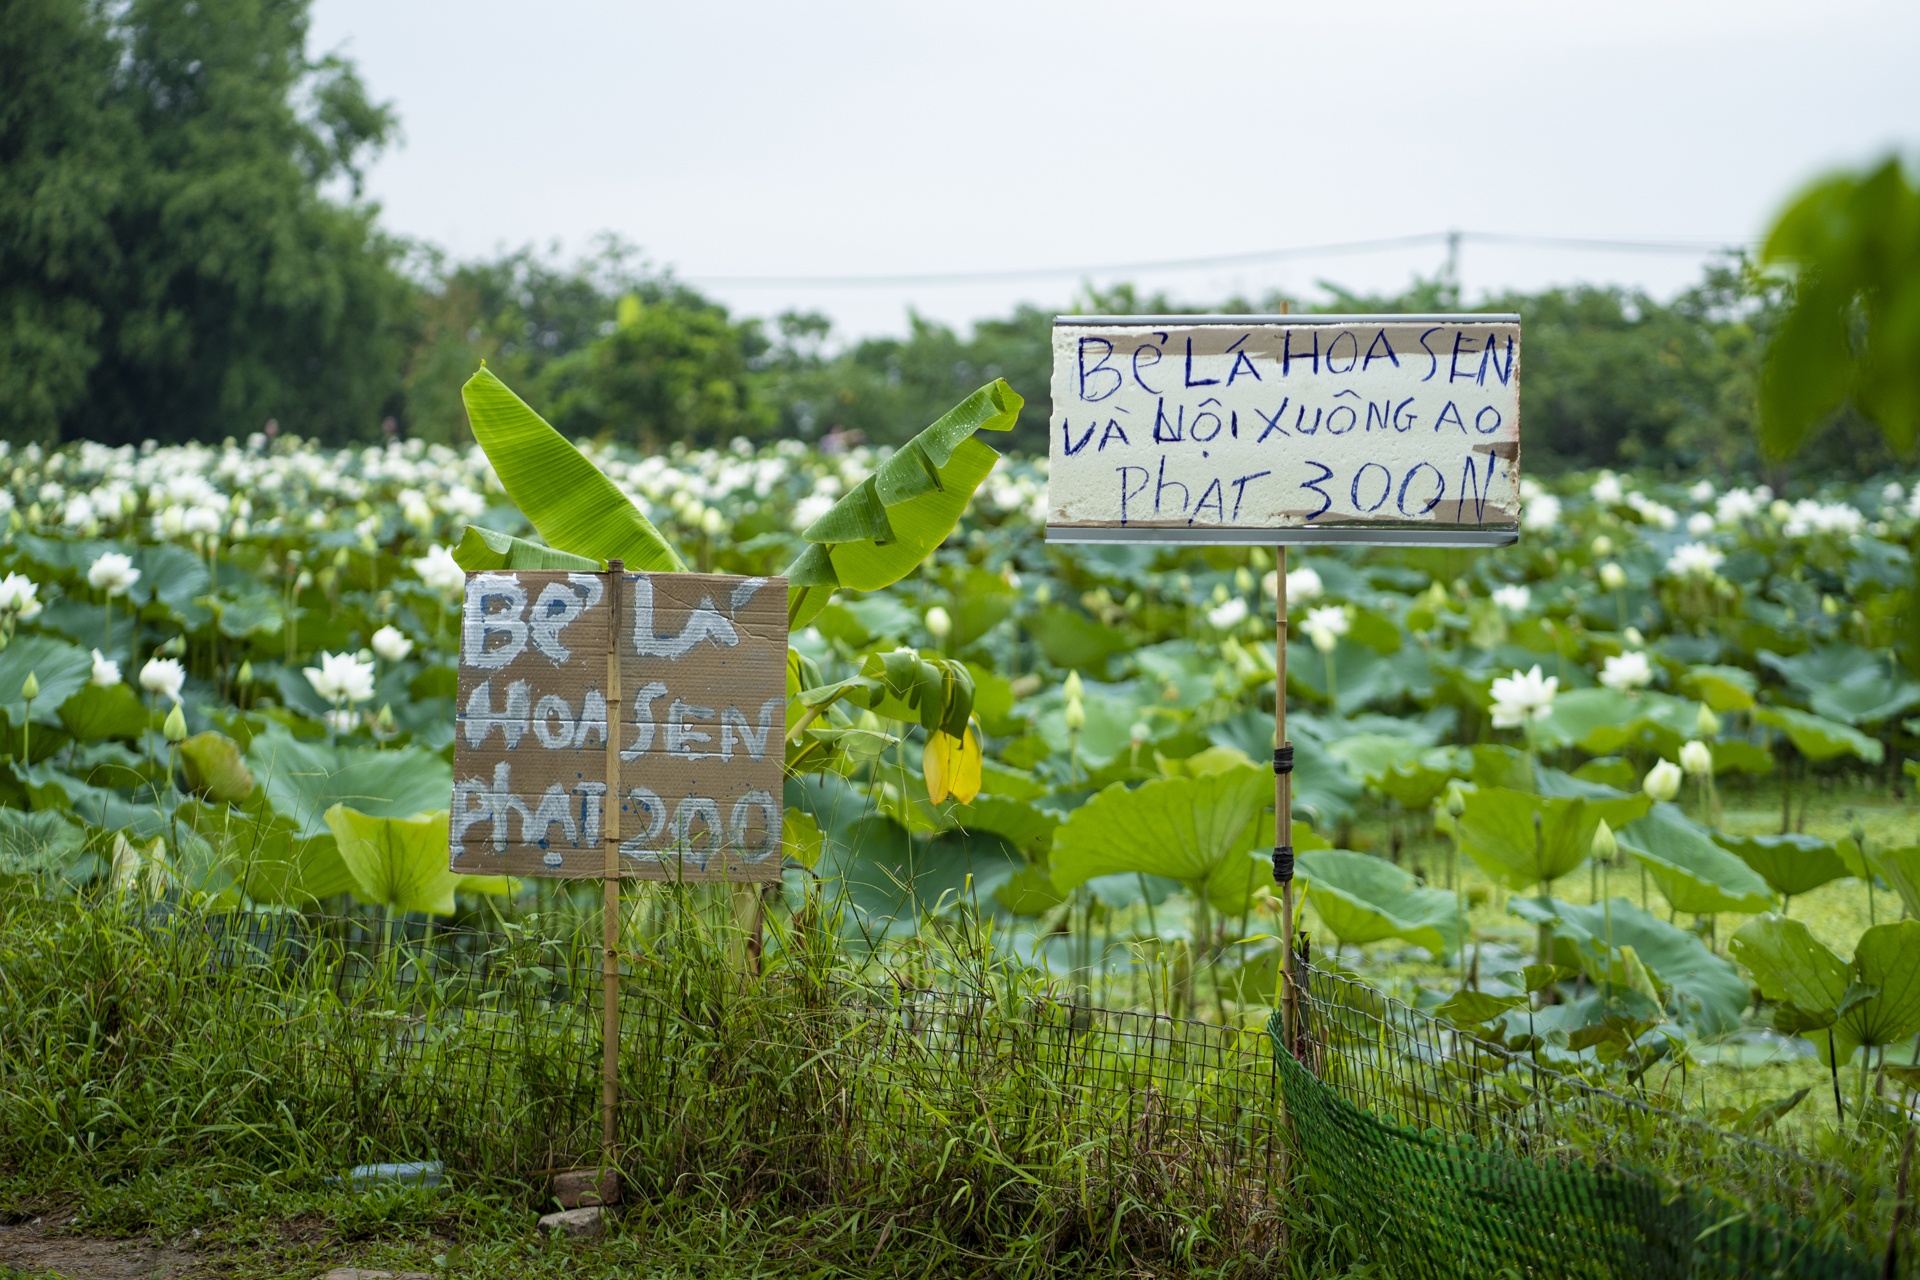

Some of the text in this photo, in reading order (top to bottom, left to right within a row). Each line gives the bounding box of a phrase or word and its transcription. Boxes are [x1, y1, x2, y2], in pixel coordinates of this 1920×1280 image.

[1185, 333, 1263, 389] LÁ
[1282, 328, 1400, 377] HOA
[1420, 327, 1514, 387] SEN
[1063, 406, 1131, 457] VÀ
[1434, 400, 1502, 435] AO
[464, 679, 784, 763] HOA SEN
[619, 786, 779, 866] 200
